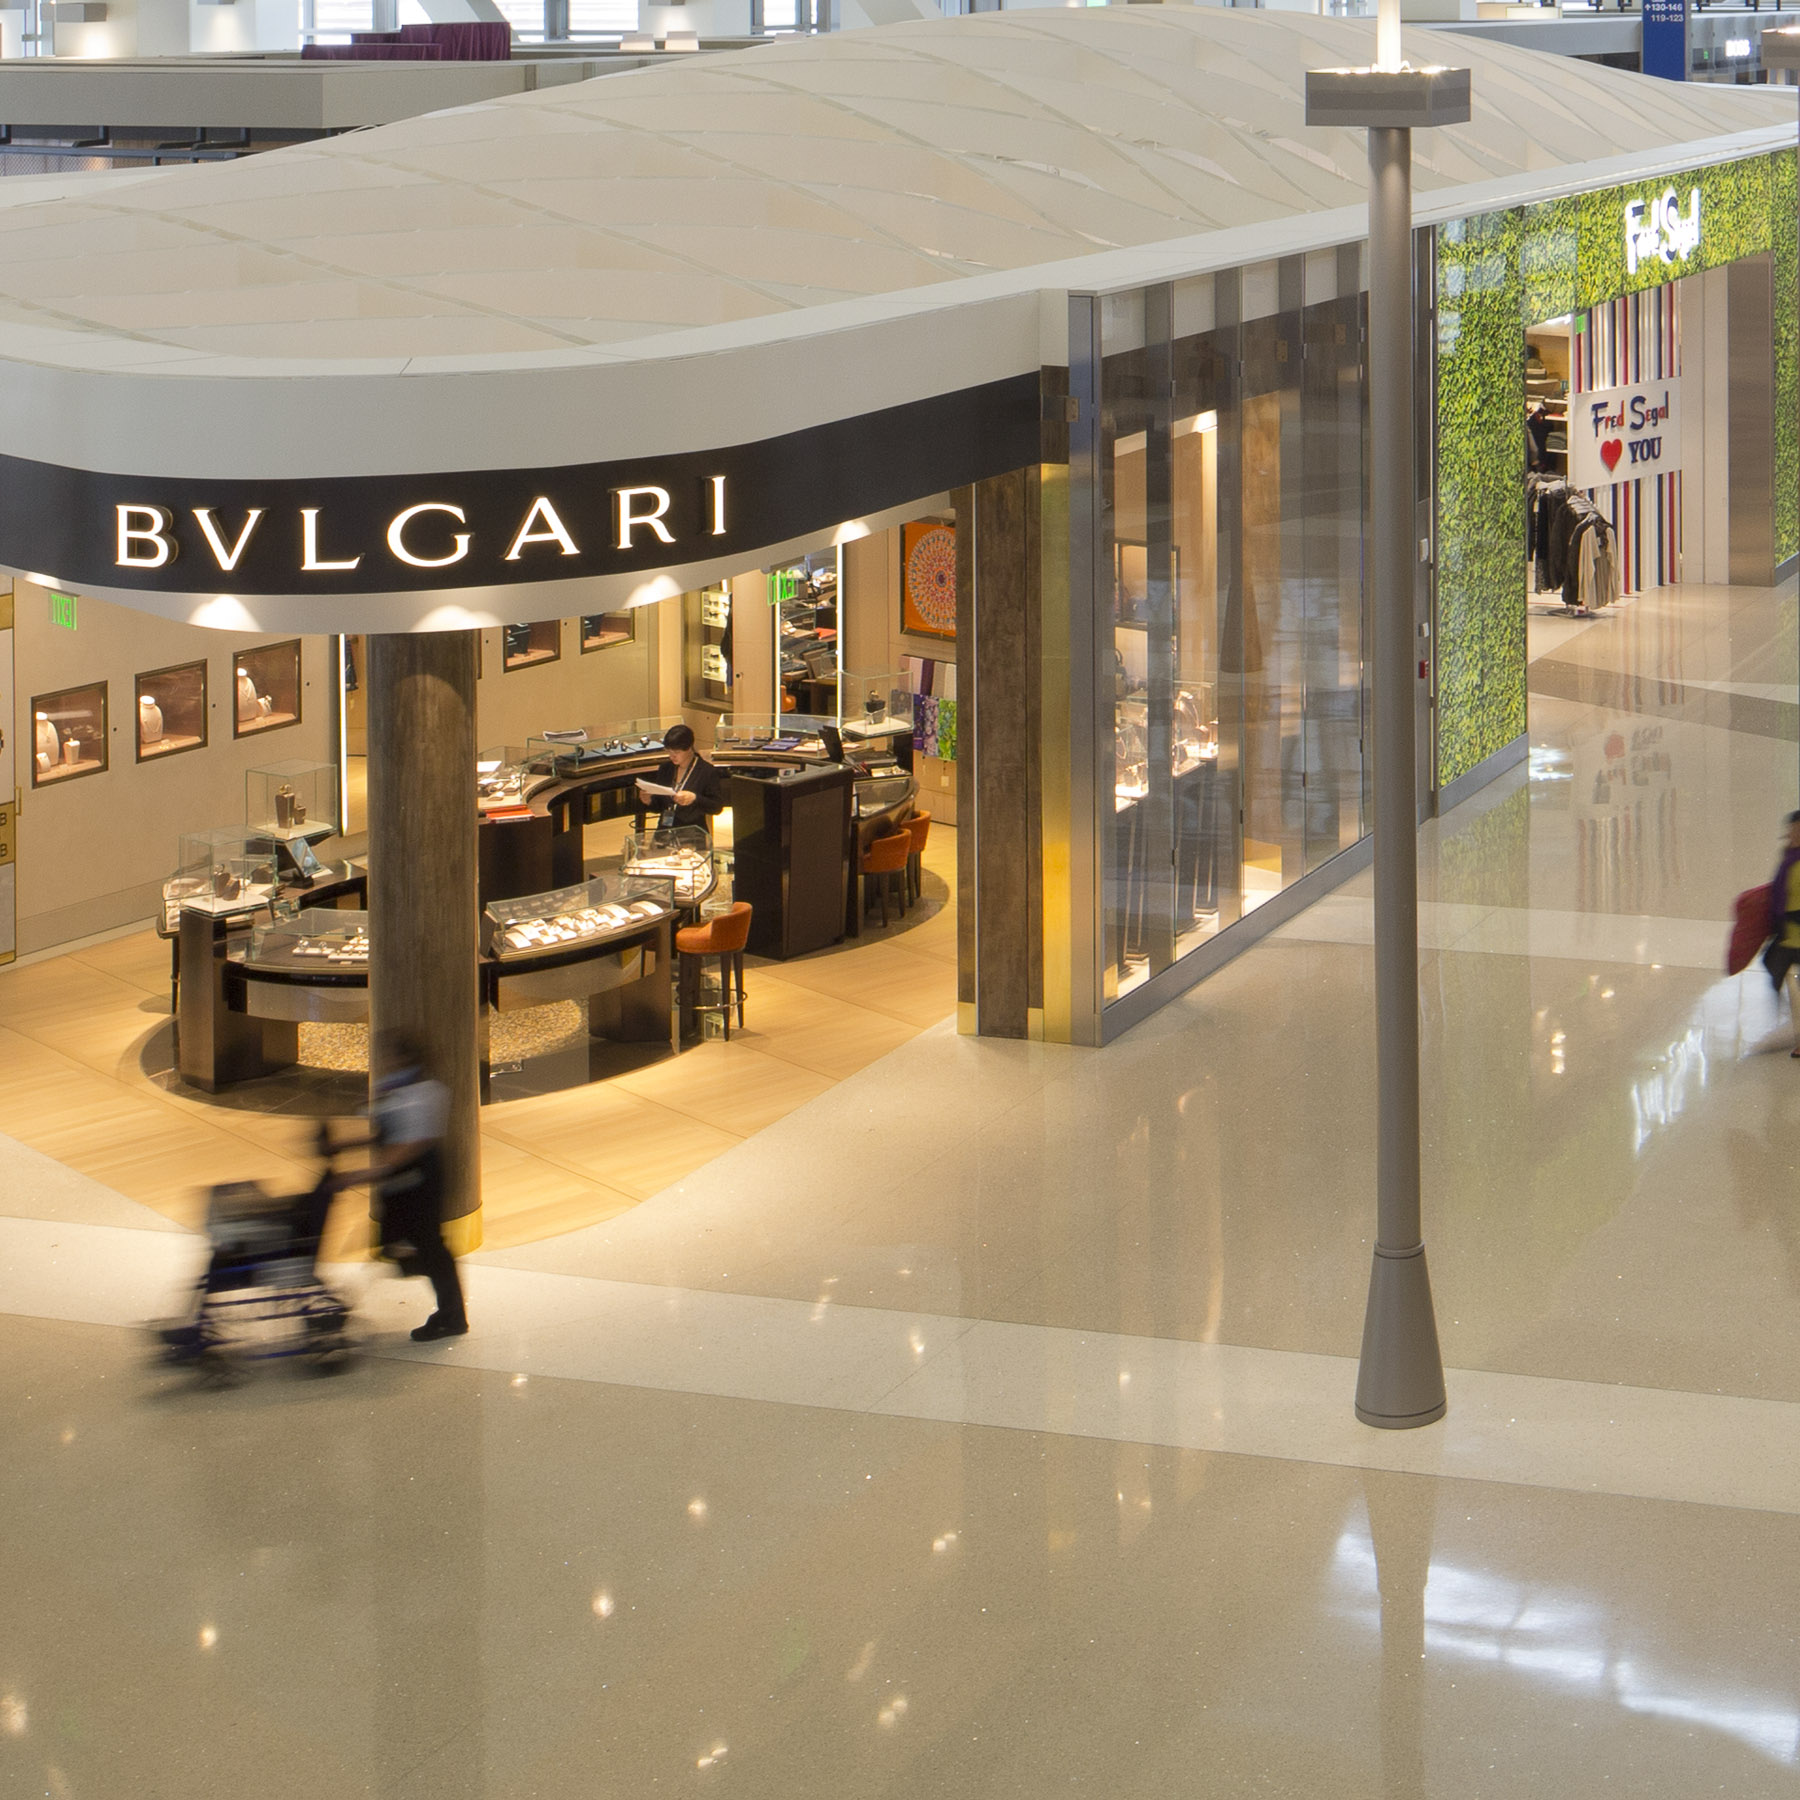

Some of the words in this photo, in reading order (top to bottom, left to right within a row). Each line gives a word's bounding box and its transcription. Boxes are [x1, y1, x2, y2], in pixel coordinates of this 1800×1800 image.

[1591, 400, 1625, 437] Fred
[1630, 391, 1669, 430] Segal
[1628, 437, 1662, 463] YOU
[114, 473, 728, 572] BVLGARI
[0, 813, 7, 826] B
[0, 844, 8, 857] B
